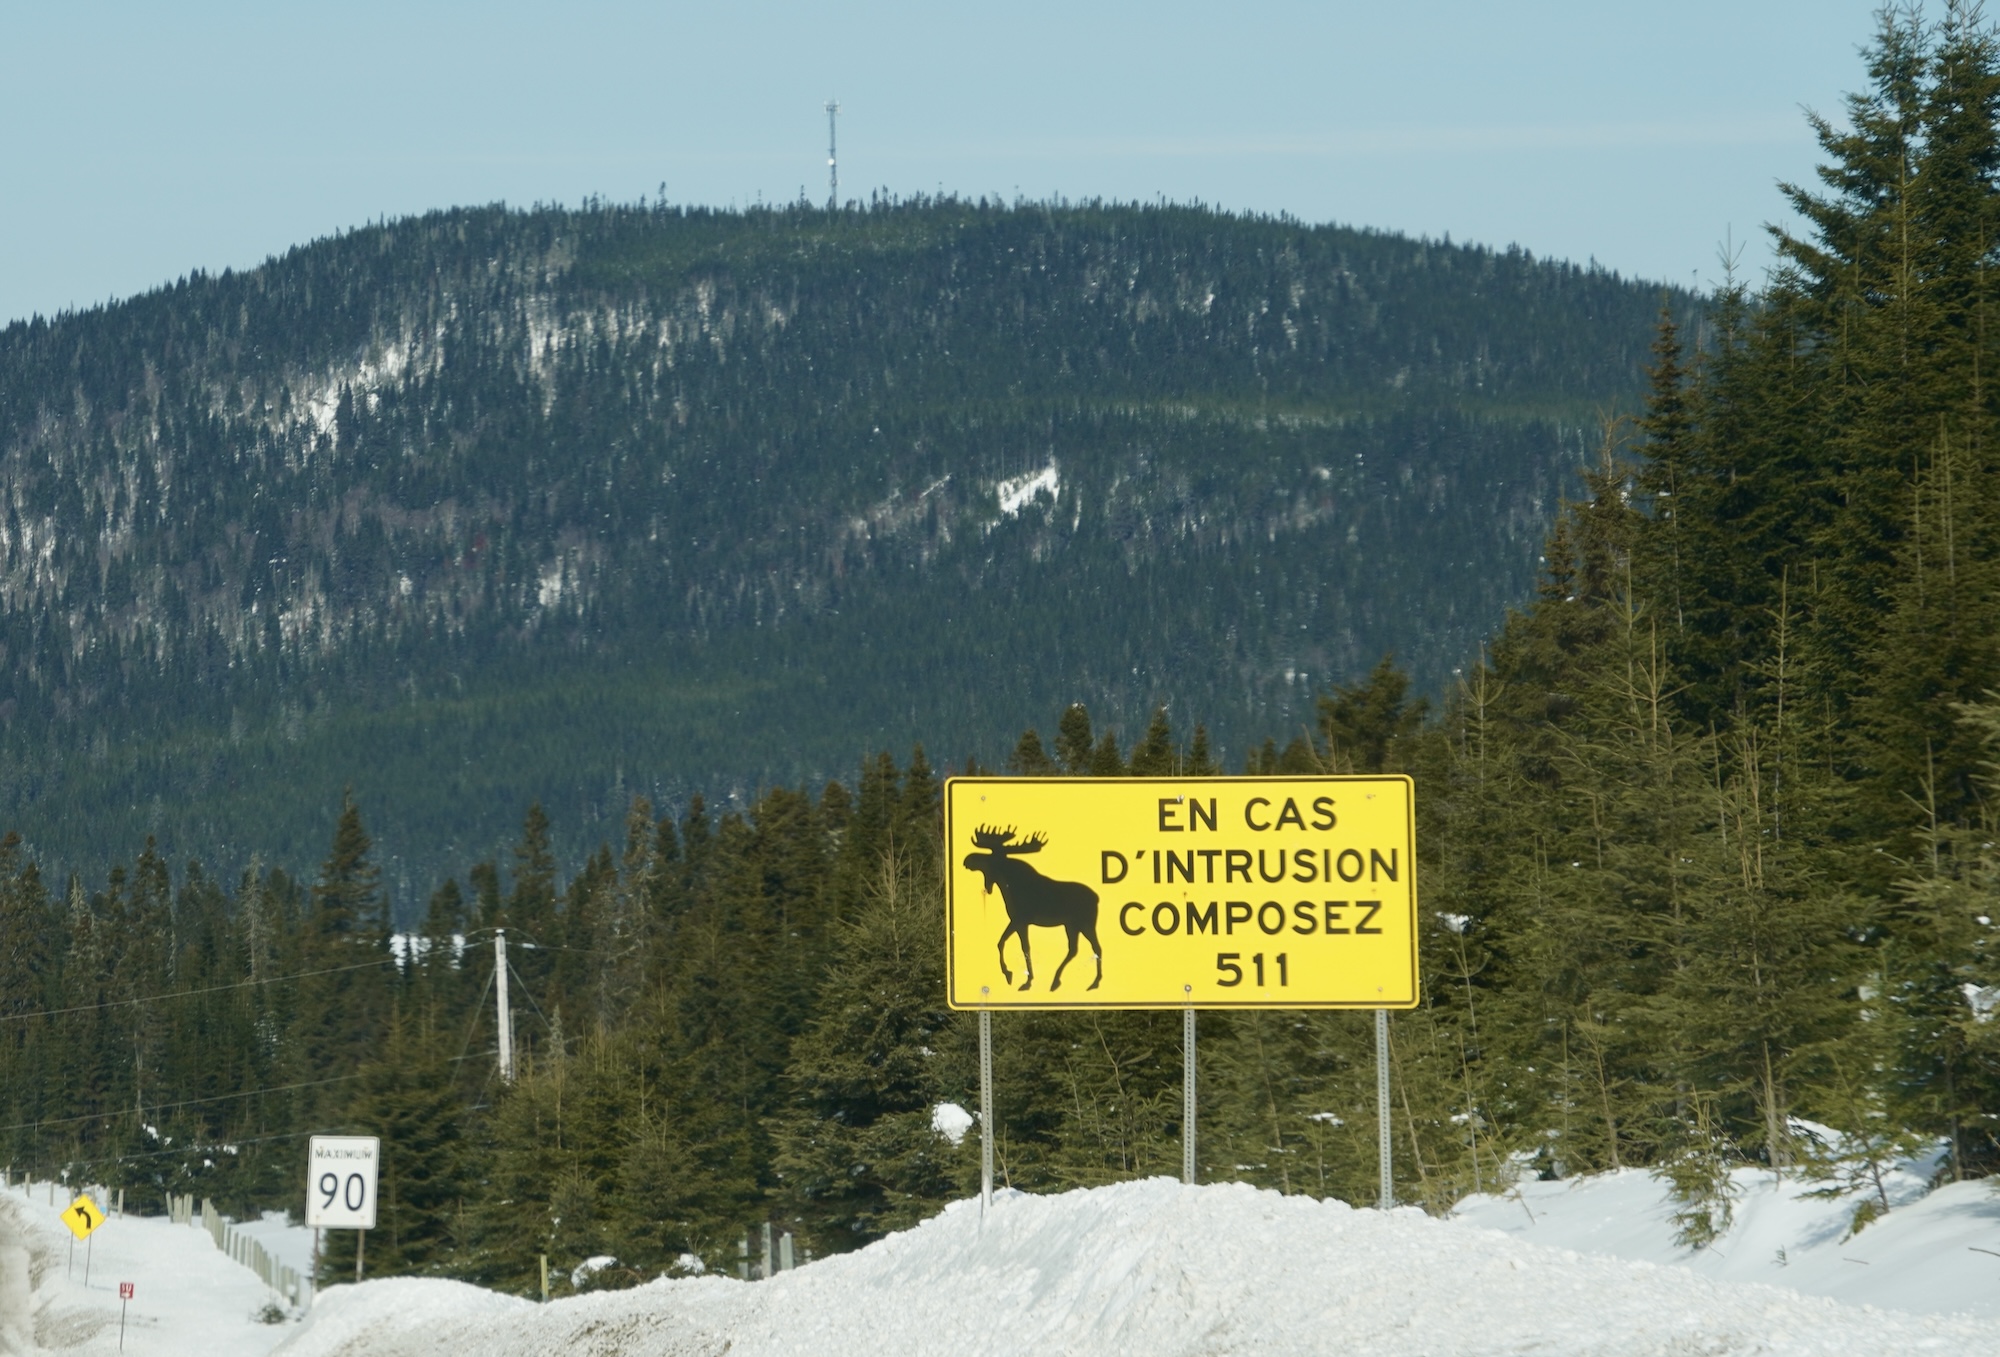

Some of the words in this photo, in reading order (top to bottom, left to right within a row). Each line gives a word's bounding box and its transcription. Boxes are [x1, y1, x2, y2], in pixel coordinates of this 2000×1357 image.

[1159, 798, 1218, 831] EN
[1244, 797, 1337, 831] CAS
[1102, 849, 1398, 884] D'INTRUSION
[1119, 901, 1382, 936] COMPOSEZ
[1216, 952, 1287, 987] 511
[315, 1149, 373, 1160] MAXIMUM
[319, 1172, 365, 1212] 90
